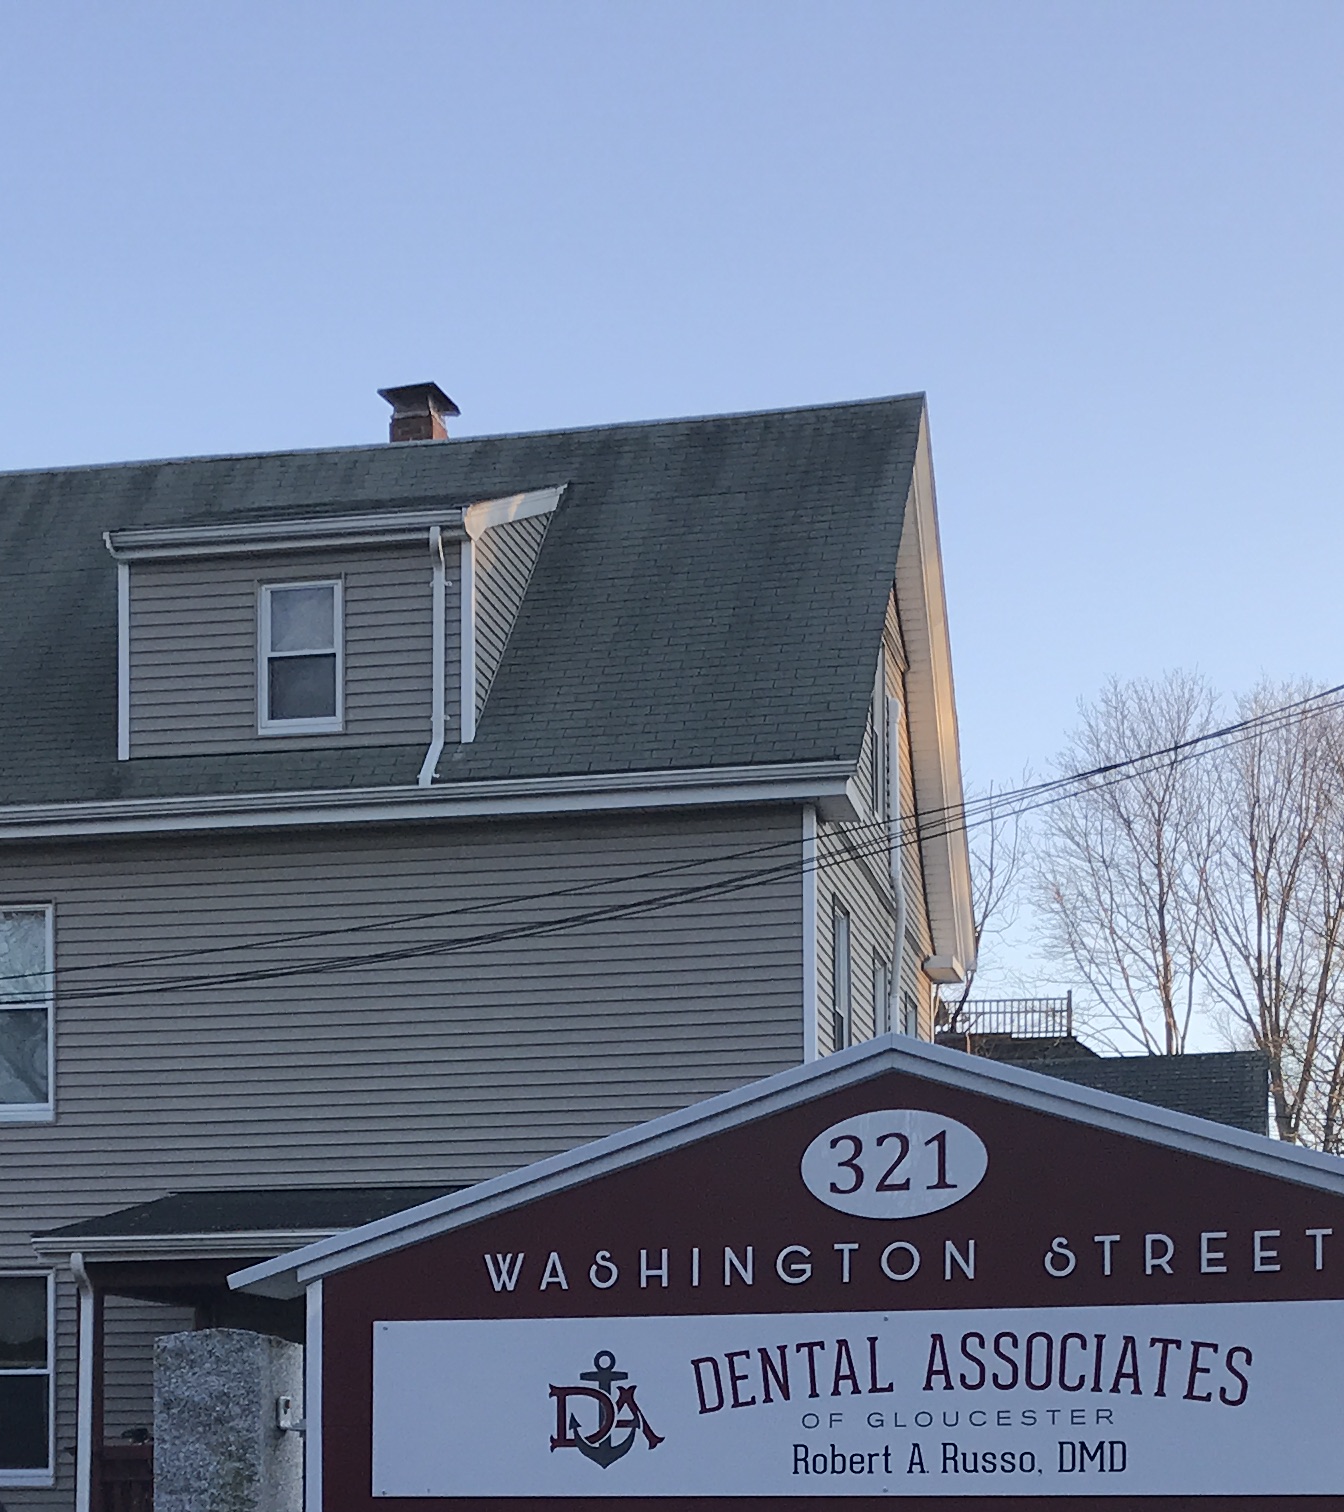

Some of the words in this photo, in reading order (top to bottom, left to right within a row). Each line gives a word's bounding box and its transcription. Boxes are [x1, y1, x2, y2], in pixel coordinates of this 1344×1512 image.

[830, 1128, 959, 1194] 321
[483, 1239, 976, 1293] WASHINGTON
[1044, 1227, 1333, 1278] STREET
[690, 1335, 895, 1415] DENTAL
[921, 1331, 1253, 1407] ASSOCIATES
[801, 1412, 844, 1429] OF
[866, 1408, 1114, 1429] GLOUCESTER
[792, 1443, 893, 1475] Robert
[940, 1442, 1043, 1477] Russo,
[1057, 1440, 1127, 1474] DMD
